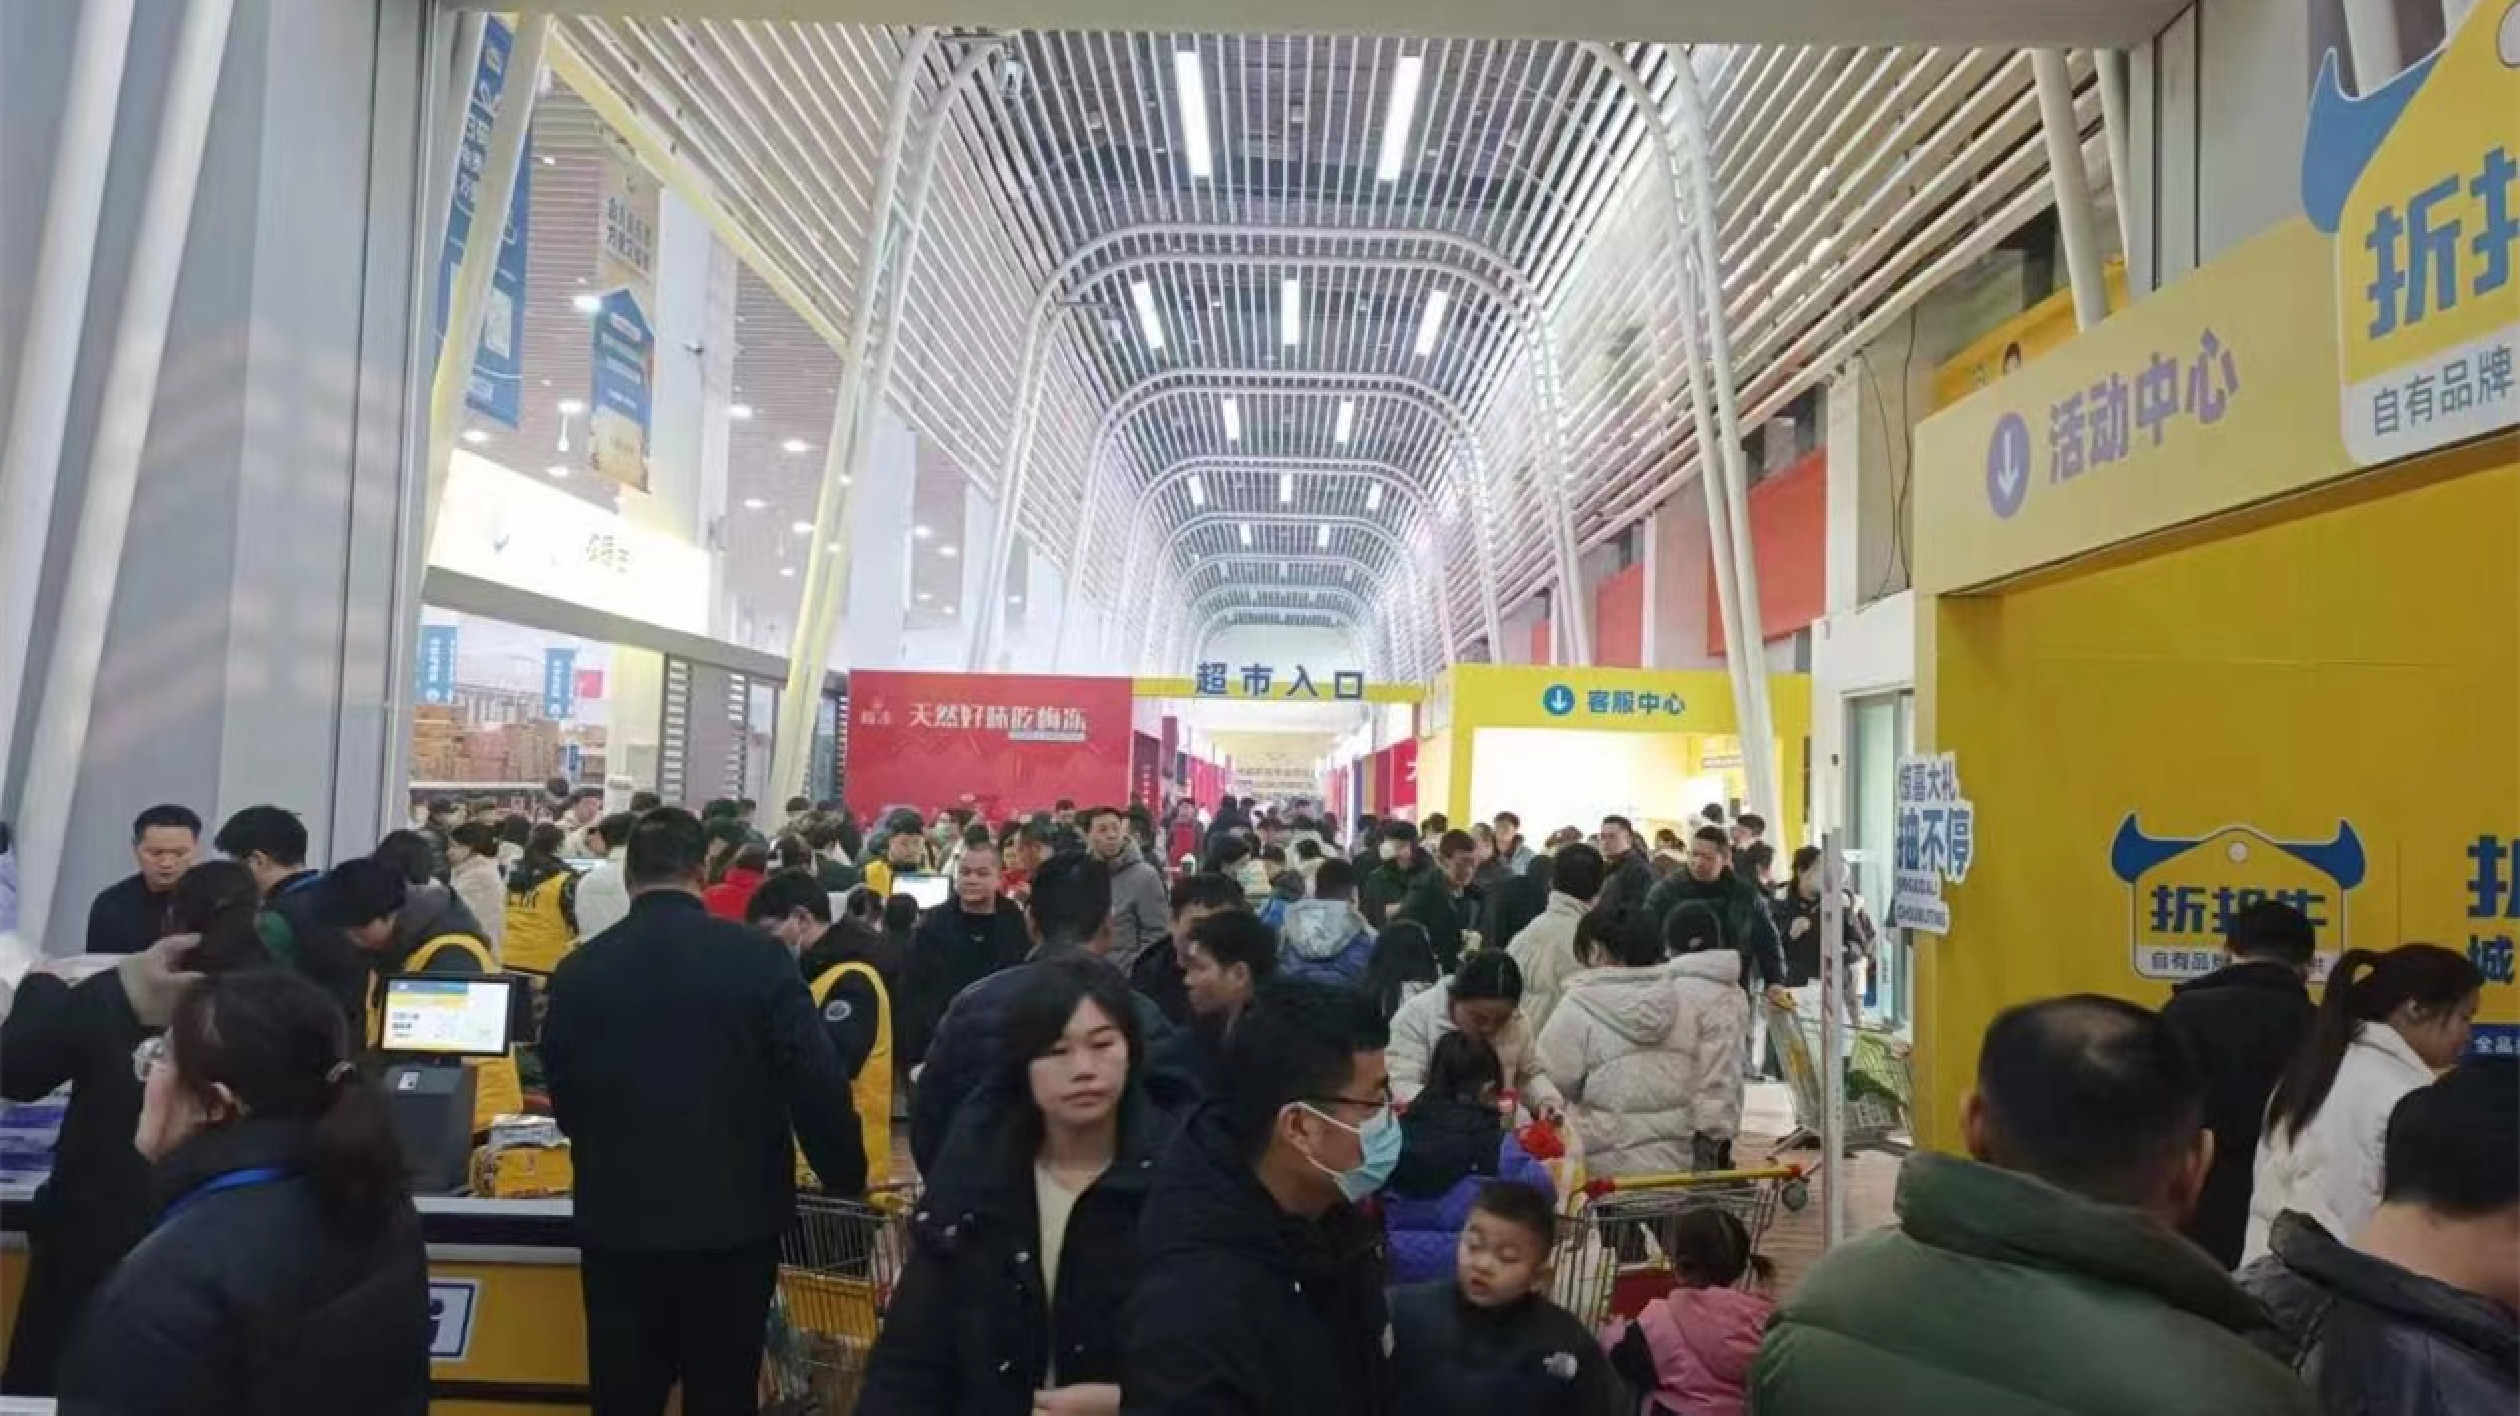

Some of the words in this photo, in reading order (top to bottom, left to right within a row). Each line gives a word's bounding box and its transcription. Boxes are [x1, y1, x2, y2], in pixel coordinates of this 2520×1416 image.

[2050, 327, 2238, 485] 活动中心
[2374, 346, 2515, 437] 自有品牌
[1196, 661, 1363, 698] 超市入口
[1588, 689, 1686, 715] 客服中心
[1898, 761, 1956, 802] 惊喜大礼
[1896, 806, 1970, 875] 抽不停
